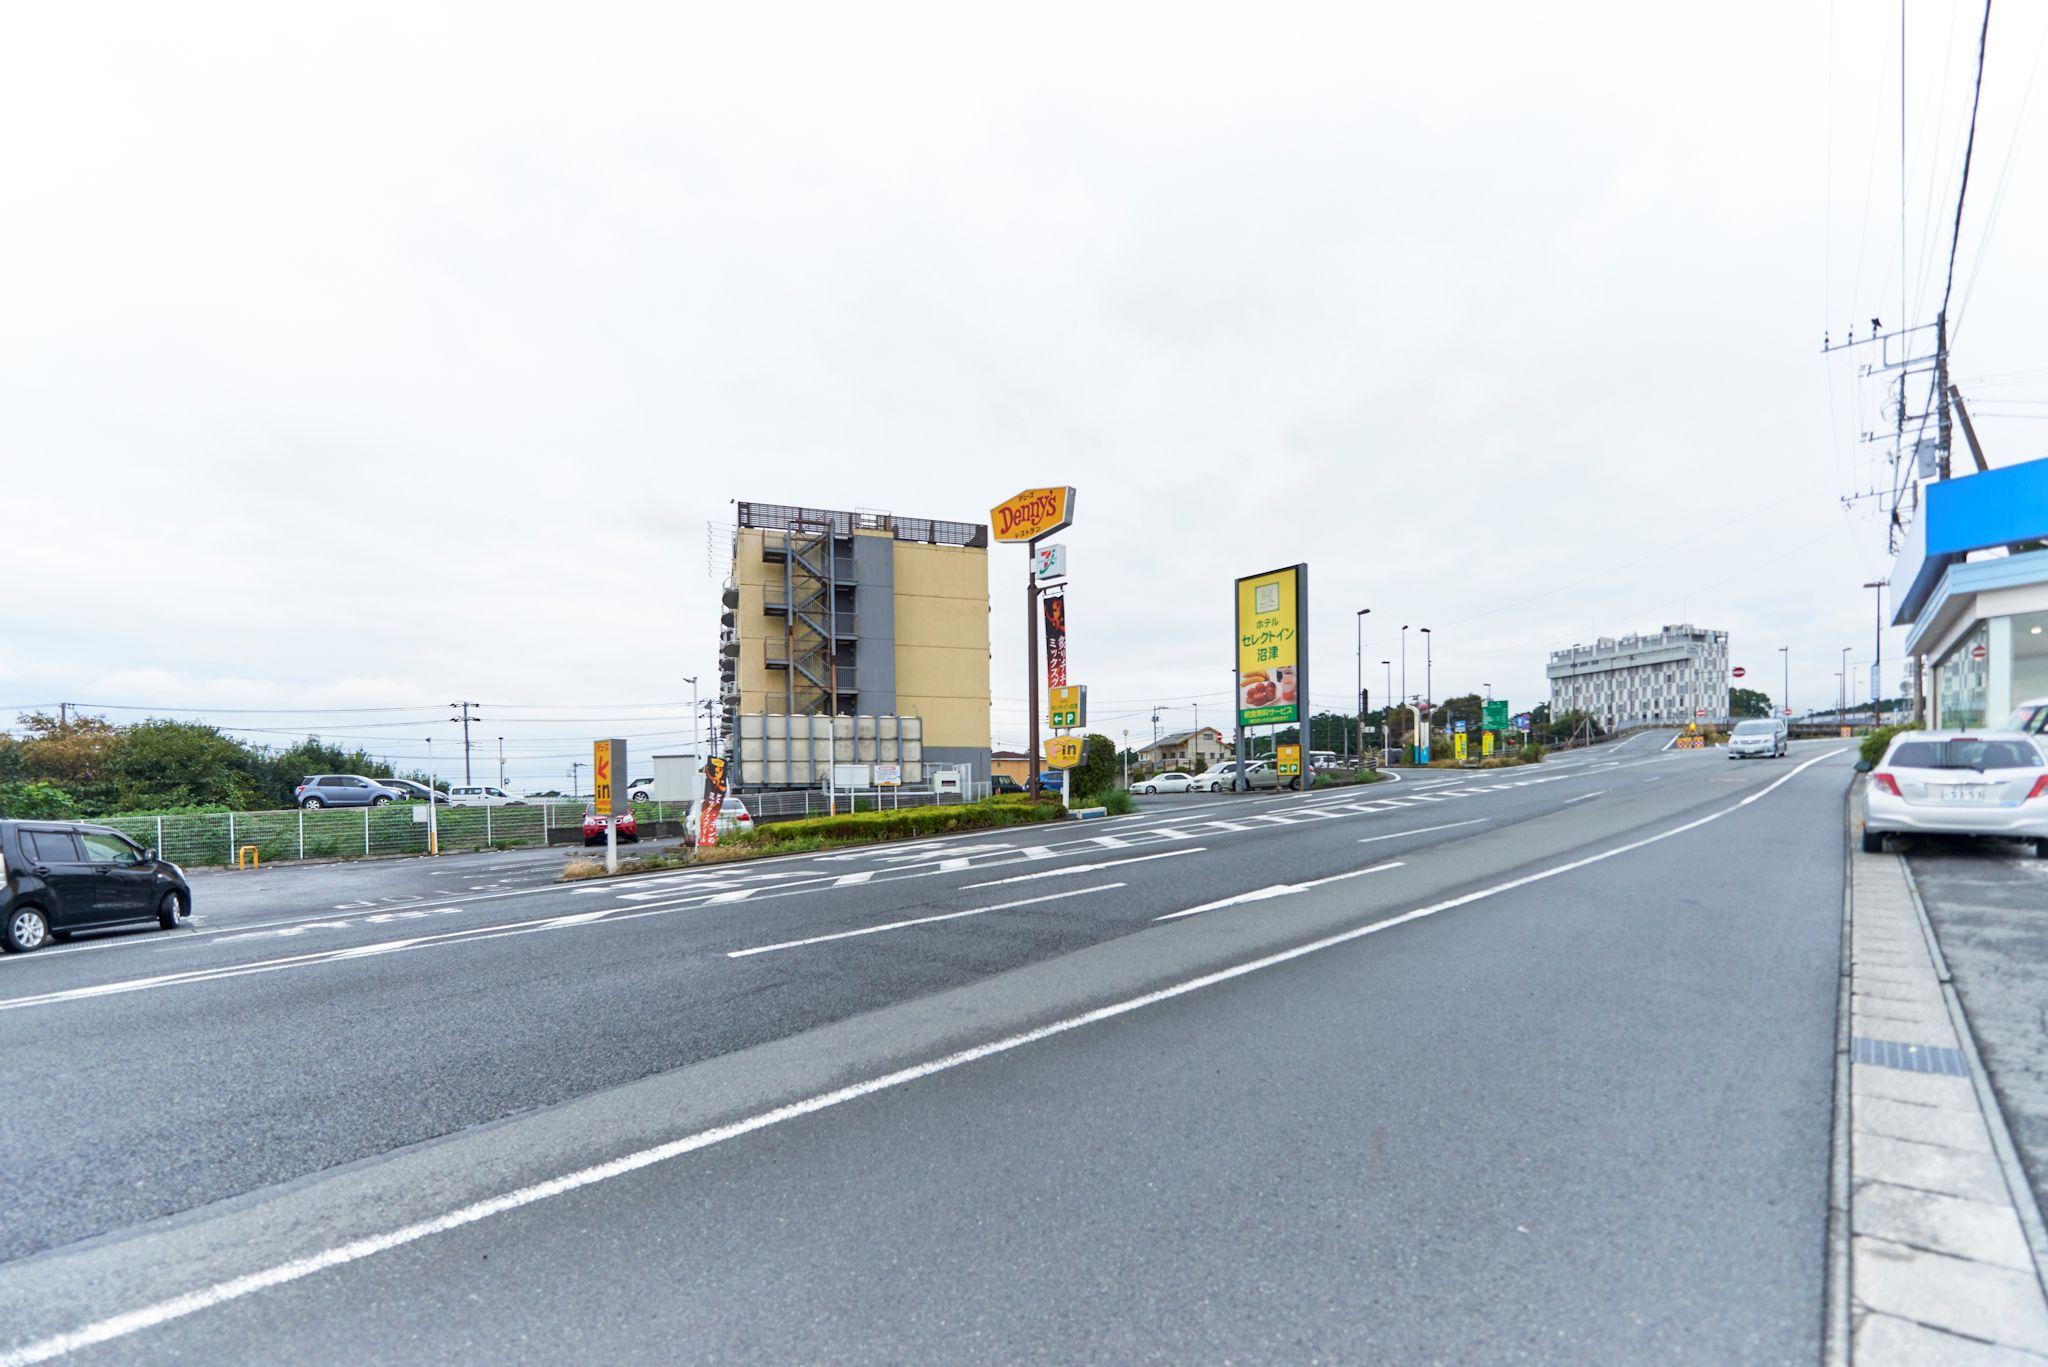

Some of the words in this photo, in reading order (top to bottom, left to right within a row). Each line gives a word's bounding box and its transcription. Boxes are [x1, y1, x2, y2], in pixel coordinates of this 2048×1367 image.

[998, 490, 1057, 535] Denny's
[1014, 526, 1042, 539] レストラン
[1256, 617, 1279, 630] ホテル
[1241, 627, 1296, 648] セレクトイン
[1257, 647, 1279, 662] 沼津
[1067, 713, 1074, 724] P
[1062, 744, 1077, 756] in
[597, 784, 610, 799] in
